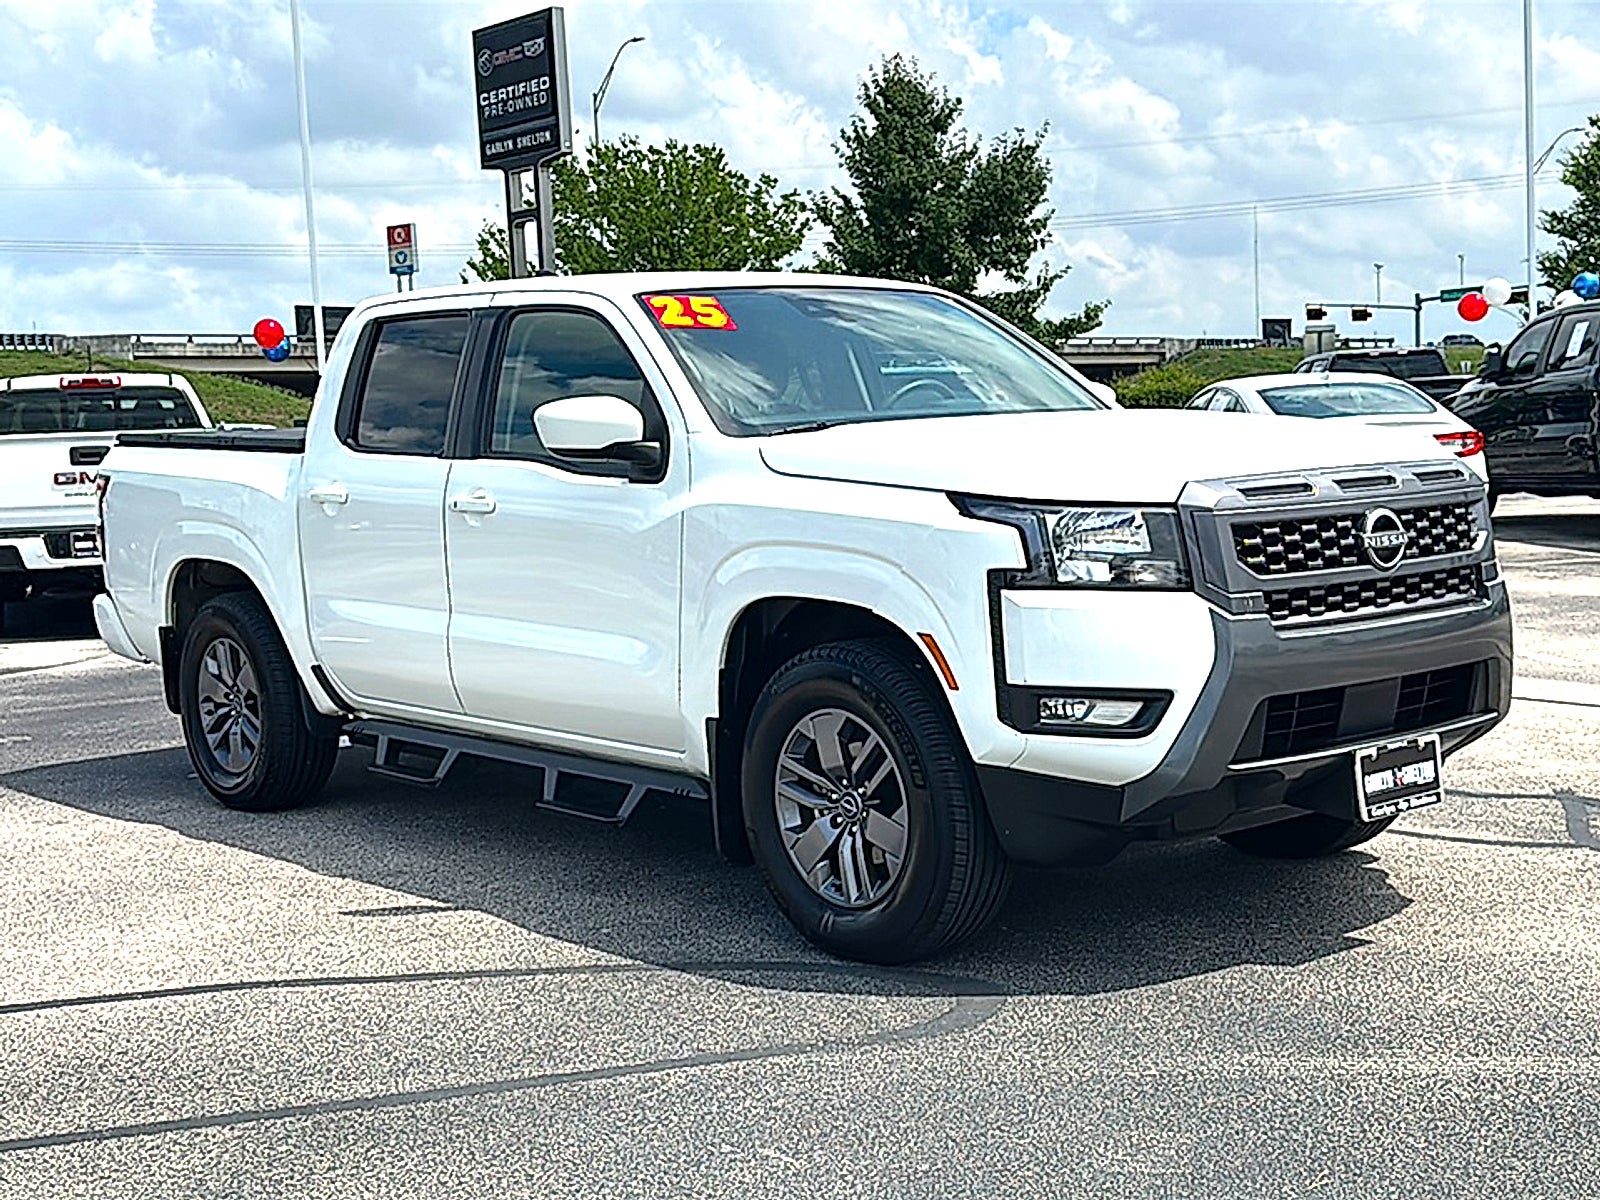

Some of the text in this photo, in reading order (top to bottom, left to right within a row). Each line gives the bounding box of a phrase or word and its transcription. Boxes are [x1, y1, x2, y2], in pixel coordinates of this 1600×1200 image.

[493, 45, 523, 66] GMC
[479, 76, 550, 106] CERTIFIED
[483, 91, 548, 119] PRE-OWNED
[516, 130, 552, 149] SHELTON
[649, 295, 728, 328] 25
